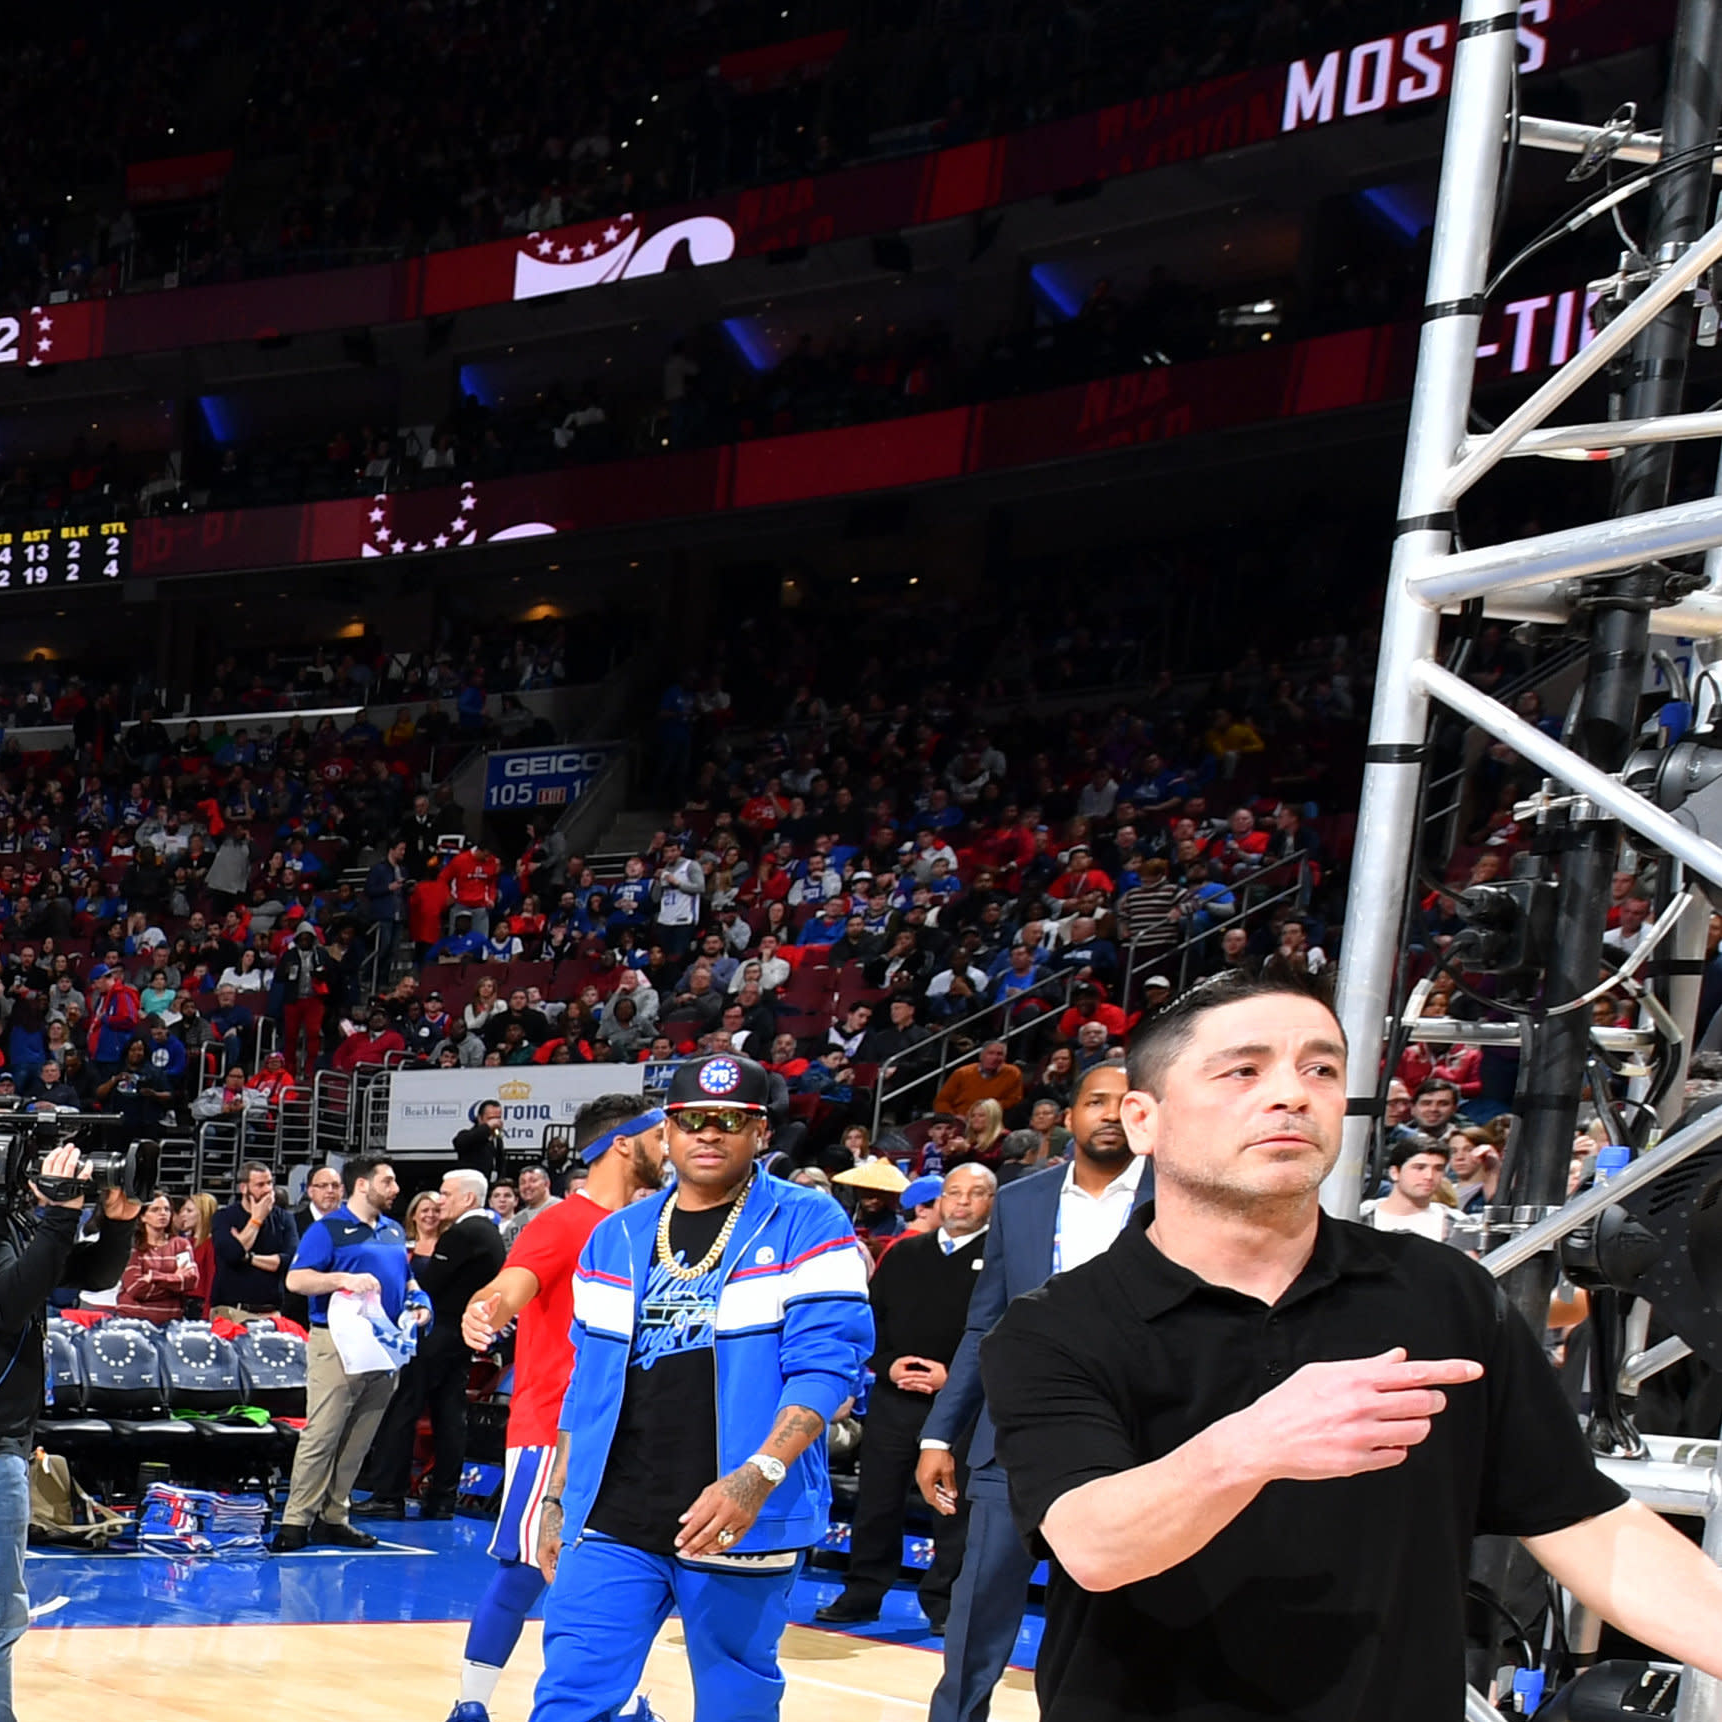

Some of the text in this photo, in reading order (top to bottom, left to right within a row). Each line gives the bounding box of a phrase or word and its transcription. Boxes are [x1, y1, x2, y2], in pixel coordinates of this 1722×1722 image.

[1280, 0, 1552, 133] MOSS
[21, 529, 52, 543] AST
[61, 525, 90, 539] BLK
[100, 522, 128, 536] STL
[23, 544, 50, 563] 13
[67, 541, 81, 559] 2
[106, 538, 120, 556] 2
[23, 566, 48, 585] 19
[66, 563, 80, 582] 2
[103, 560, 119, 578] 4
[504, 752, 605, 777] GEICO
[490, 782, 533, 806] 105
[404, 1104, 458, 1117] Beach House
[468, 1099, 552, 1124] Crona
[503, 1125, 534, 1139] xtra
